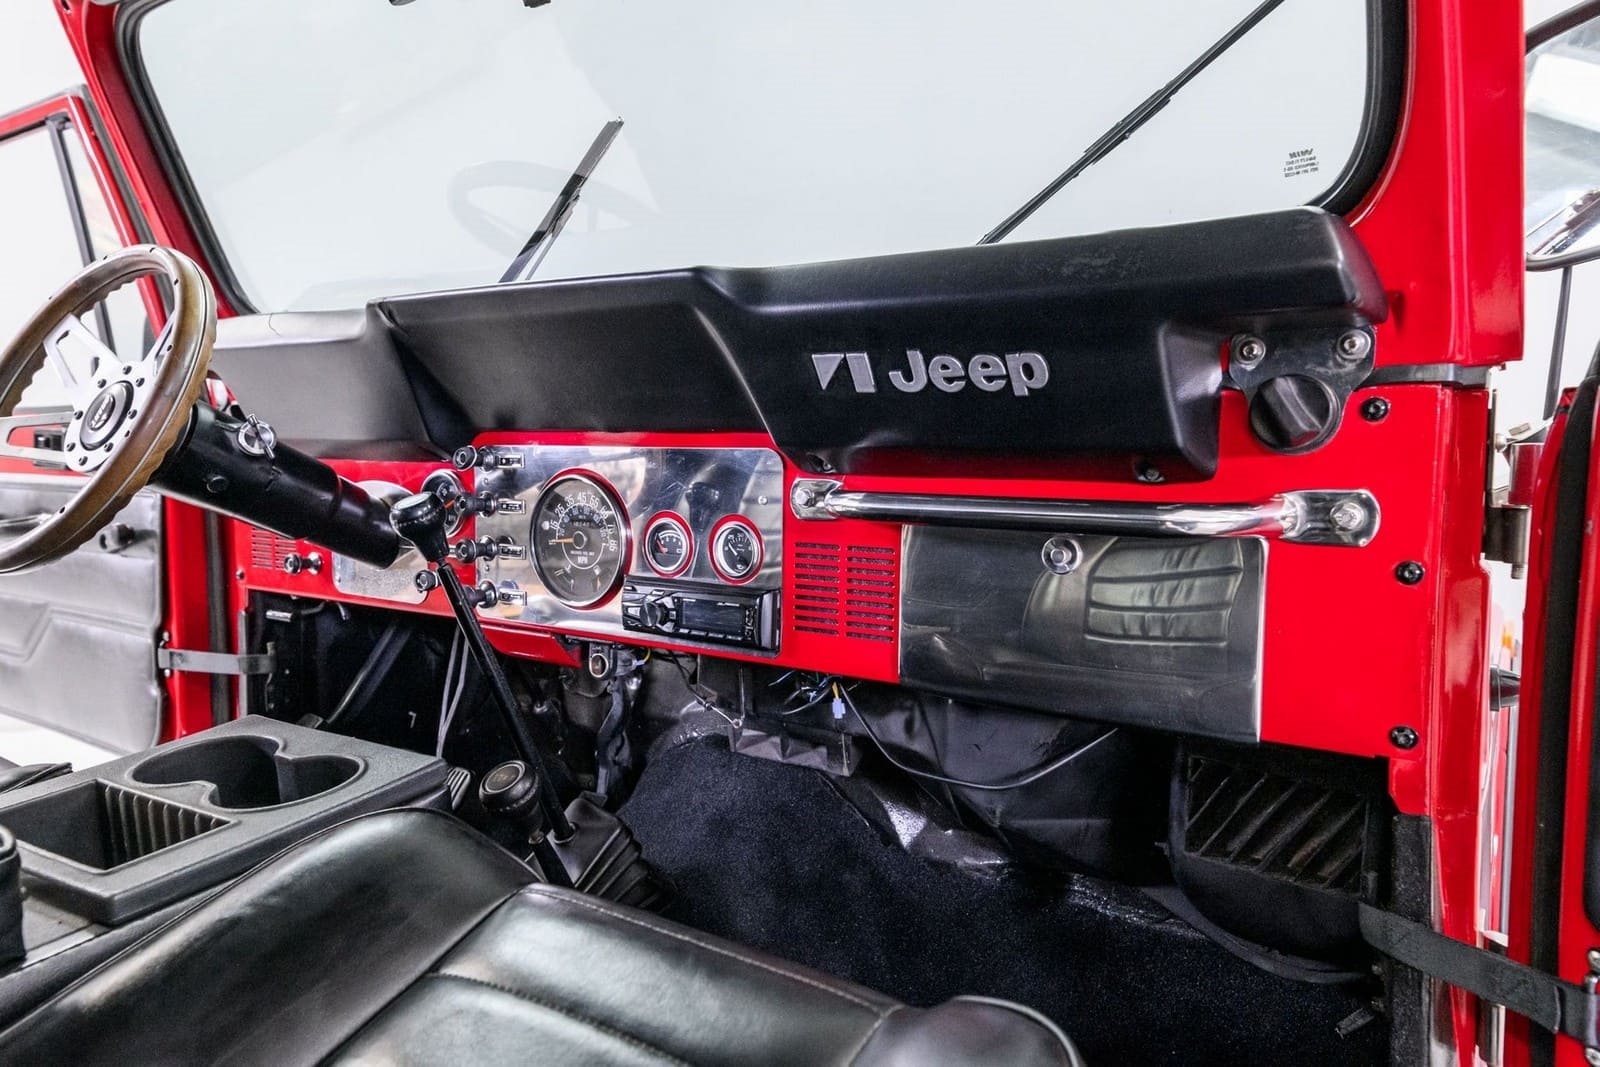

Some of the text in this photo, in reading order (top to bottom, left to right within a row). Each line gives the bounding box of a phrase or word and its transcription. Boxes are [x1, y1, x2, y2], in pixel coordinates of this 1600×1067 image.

[888, 350, 1049, 396] Jeep
[565, 494, 575, 506] 35
[577, 492, 587, 503] 45
[554, 503, 565, 517] 25
